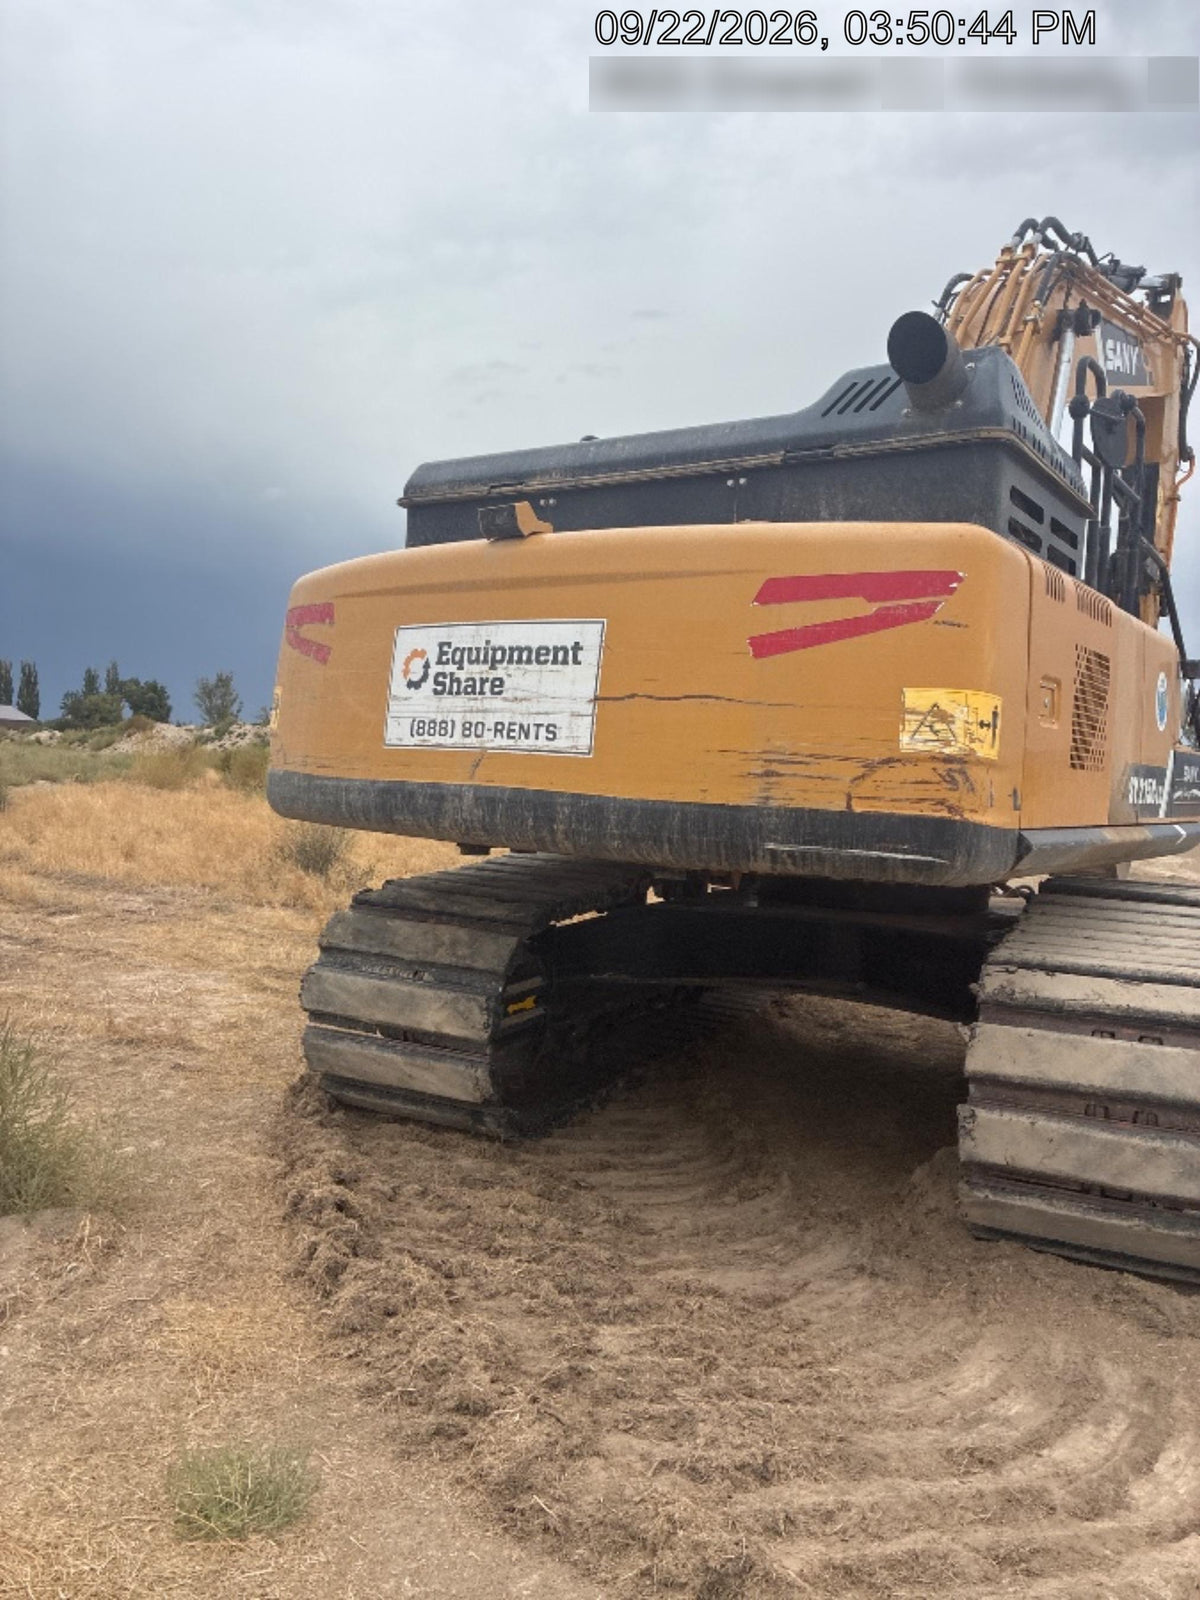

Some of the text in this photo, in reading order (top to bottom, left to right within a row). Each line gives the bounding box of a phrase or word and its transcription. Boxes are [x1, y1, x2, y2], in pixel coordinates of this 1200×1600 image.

[1105, 338, 1139, 376] SANY
[435, 640, 583, 670] Equipment
[432, 671, 505, 696] Share
[409, 717, 558, 742] (888) 80-RENTS
